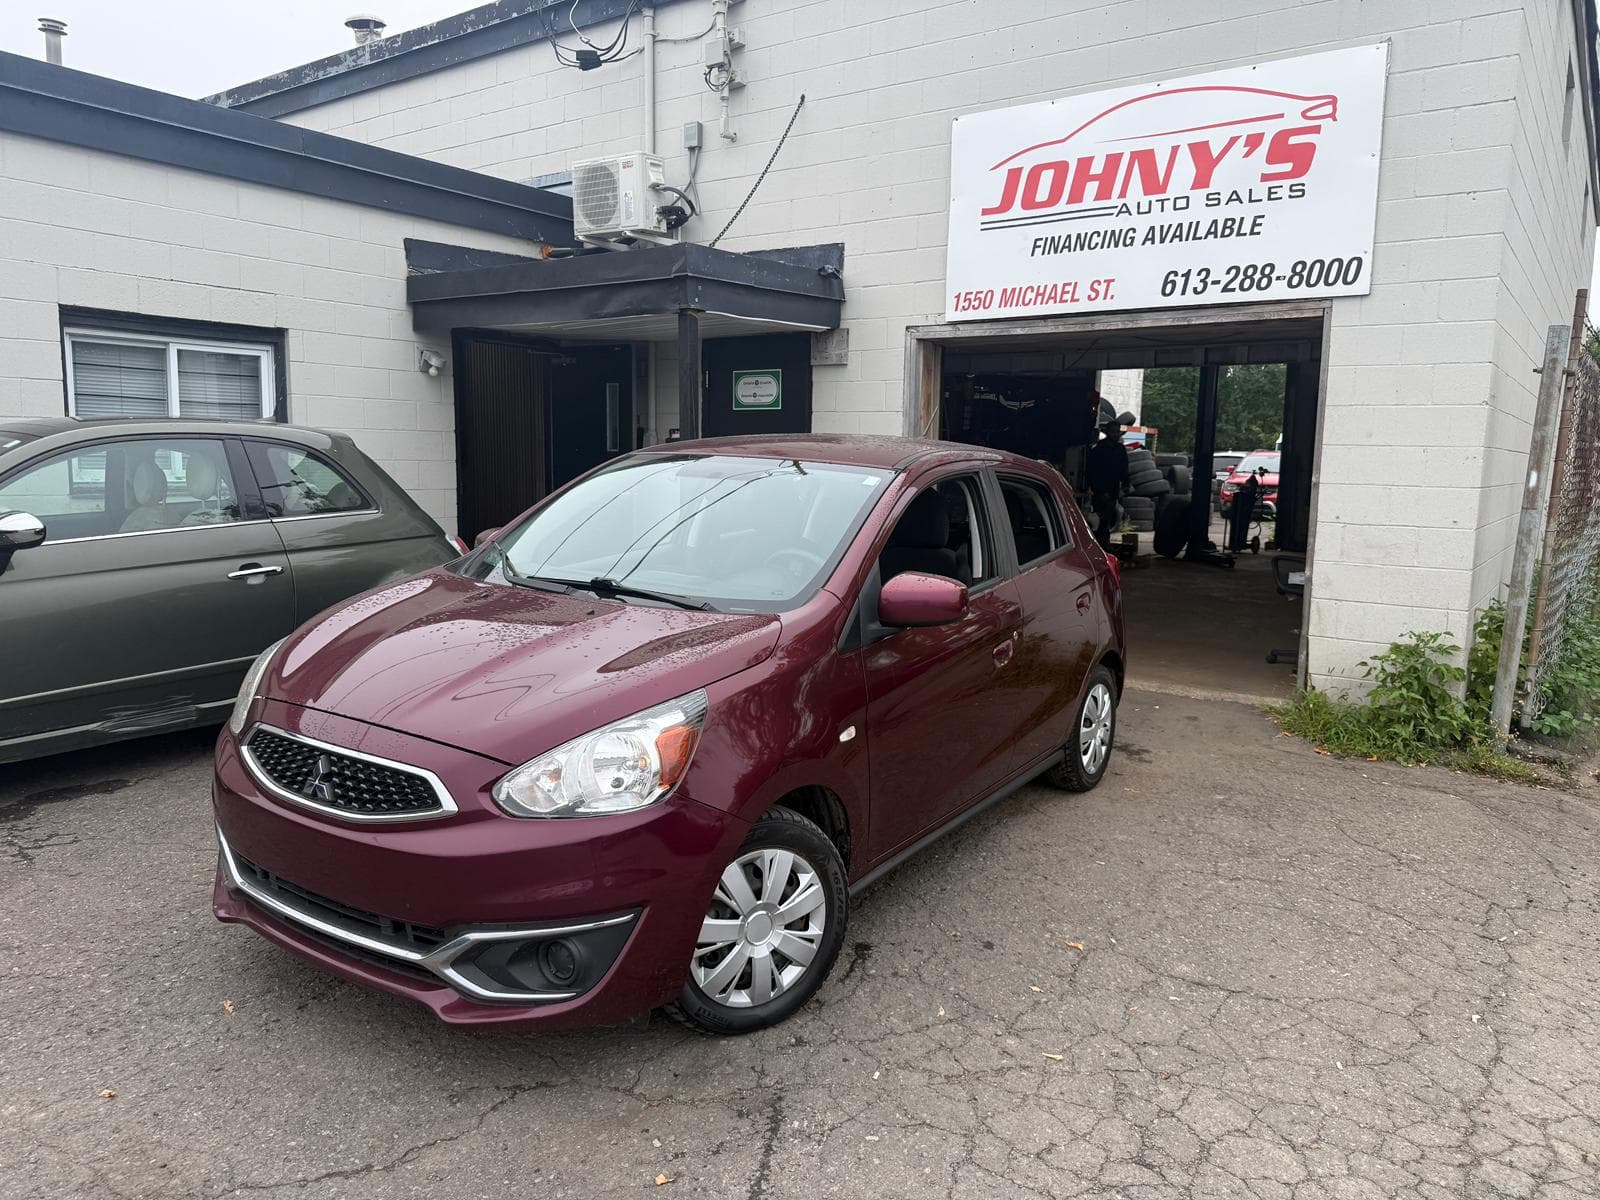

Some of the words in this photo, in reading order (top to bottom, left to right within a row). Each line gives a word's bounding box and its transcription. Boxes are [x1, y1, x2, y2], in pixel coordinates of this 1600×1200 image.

[981, 124, 1322, 216] JOHNY'S
[1115, 195, 1190, 217] AUTO
[1205, 182, 1306, 208] SALES
[1030, 227, 1137, 257] FINANCING
[1141, 214, 1266, 246] AVAILABLE
[954, 289, 994, 312] 1550
[998, 281, 1080, 309] MICHAEL
[1087, 278, 1116, 302] ST.
[1160, 256, 1363, 298] 613-288-8000
